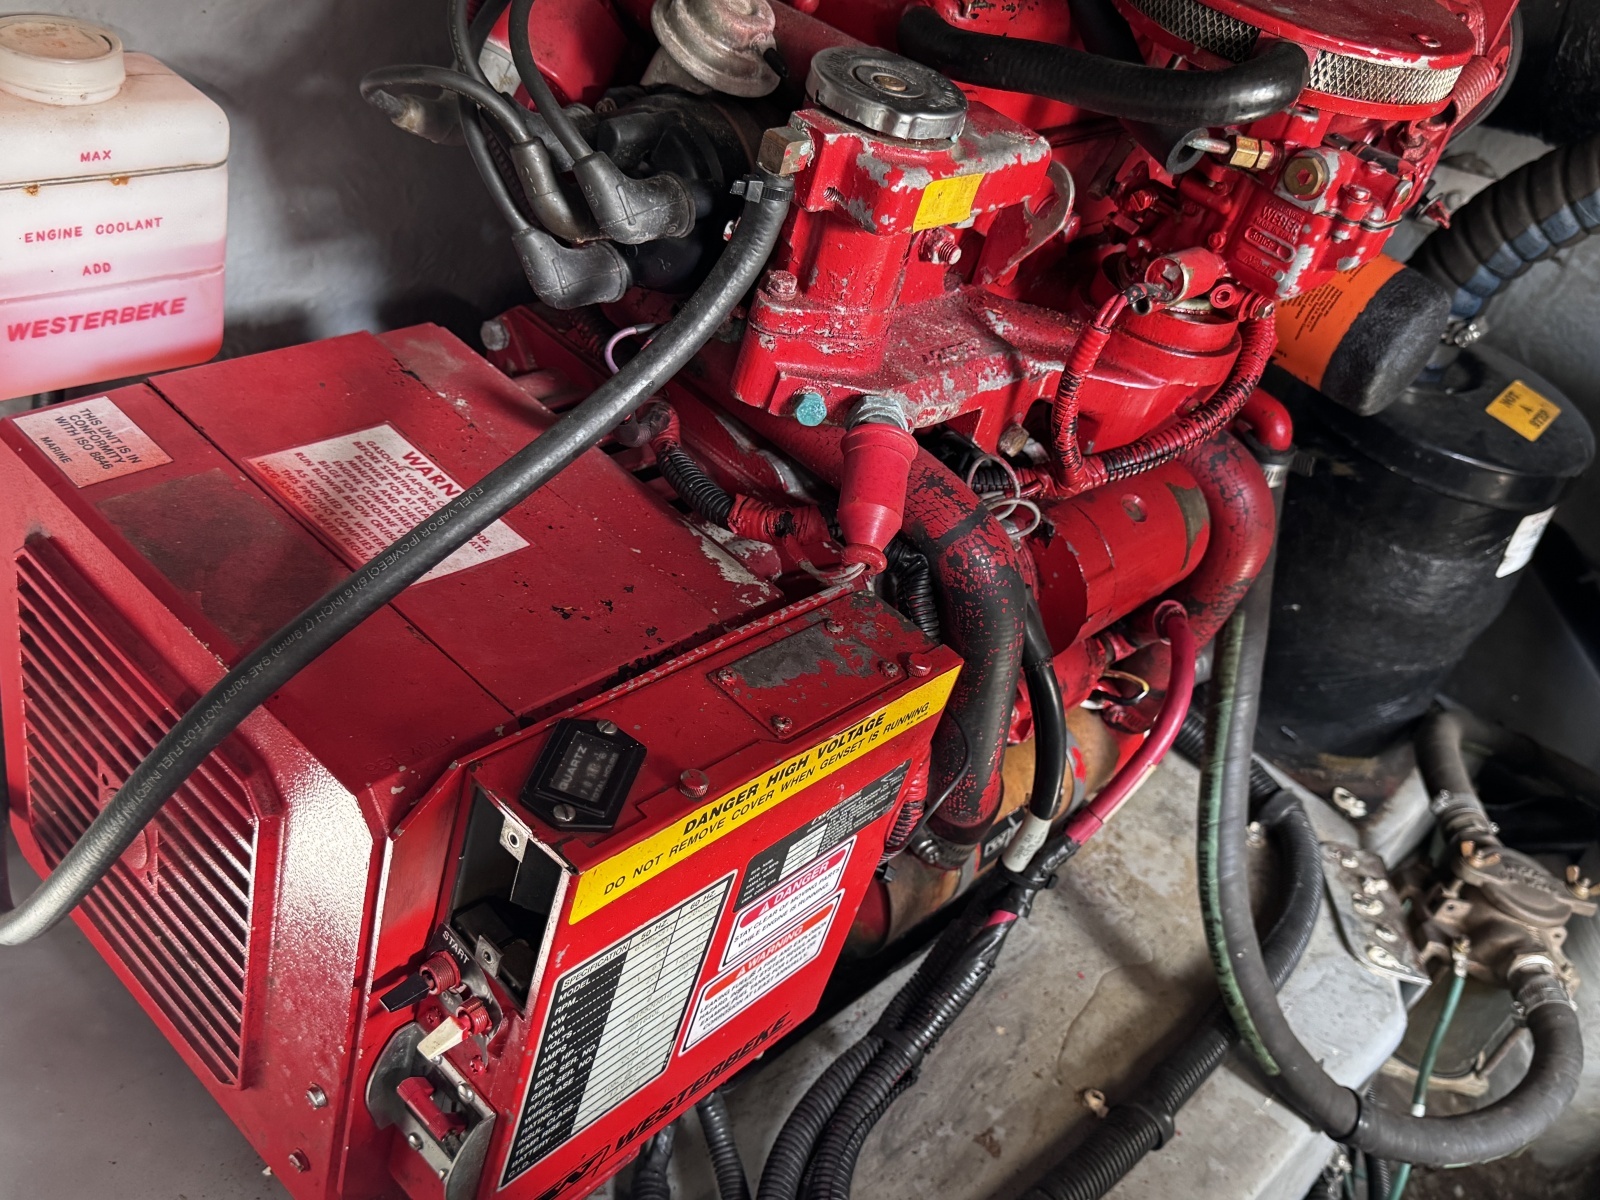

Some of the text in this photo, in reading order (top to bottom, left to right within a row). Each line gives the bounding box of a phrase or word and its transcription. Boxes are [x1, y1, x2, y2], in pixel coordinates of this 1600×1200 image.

[80, 150, 112, 162] MAX
[25, 217, 163, 243] ENGINE COOLANT
[82, 262, 111, 276] ADD
[7, 297, 187, 341] WESTERBEKE
[40, 436, 72, 464] MARINE
[55, 416, 79, 436] WITH
[75, 437, 95, 451] ISO
[69, 414, 127, 464] CONFORMITY
[80, 408, 142, 464] THIS UNIT IS IN
[352, 441, 437, 513] BEFORE STARTING ENG
[366, 440, 438, 500] GASOLINE VAPORS
[402, 451, 462, 497] WARN
[295, 469, 309, 479] AS
[307, 480, 343, 510] SUPPLIED
[295, 452, 399, 542] RUN BLOWER BELOW CRUIS
[318, 460, 399, 529] BILGE FOR GASOLINE
[333, 460, 415, 529] ENGINE COMPARTMEN
[345, 460, 421, 524] MINUTES AND CHEC
[354, 455, 431, 519] BLOWER FOR AT LEA
[454, 487, 484, 508] FUEL
[420, 508, 458, 538] VAPOR
[316, 595, 345, 623] INCH
[201, 700, 224, 728] NOT
[180, 723, 203, 748] FOR
[158, 745, 184, 771] FUEL
[559, 745, 587, 791] QUARTZ
[683, 783, 759, 836] DANGER
[765, 755, 810, 788] HIGH
[817, 712, 887, 760] VOLTAGE
[604, 875, 626, 896] DO
[632, 853, 664, 879] NOT
[668, 817, 727, 858] REMOVE
[731, 789, 775, 820] COVER
[780, 766, 816, 793] WHEN
[819, 738, 866, 770] GENSET
[868, 730, 880, 744] IS
[883, 701, 930, 735] RUNNING
[773, 861, 830, 905] DANGER
[733, 927, 754, 943] STAY
[754, 910, 779, 929] CLEAR
[443, 930, 469, 963] START
[563, 943, 629, 988] SPECIFICATION
[640, 929, 652, 940] 50
[690, 899, 702, 910] 60
[747, 925, 804, 968] WARNING
[554, 997, 577, 1016] RPM
[558, 978, 591, 1003] MODEL
[547, 1025, 566, 1041] KVA
[551, 1013, 568, 1029] KW
[540, 1044, 568, 1066] AMPS
[544, 1031, 573, 1053] VOLTS
[581, 1043, 598, 1057] NO.
[537, 1060, 559, 1078] ENG.
[578, 1056, 593, 1070] NO.
[527, 1076, 575, 1114] PF/PHASE
[615, 1012, 789, 1151] WESTERBEKE
[541, 1122, 561, 1139] RISE
[511, 1136, 551, 1169] BATTERY
